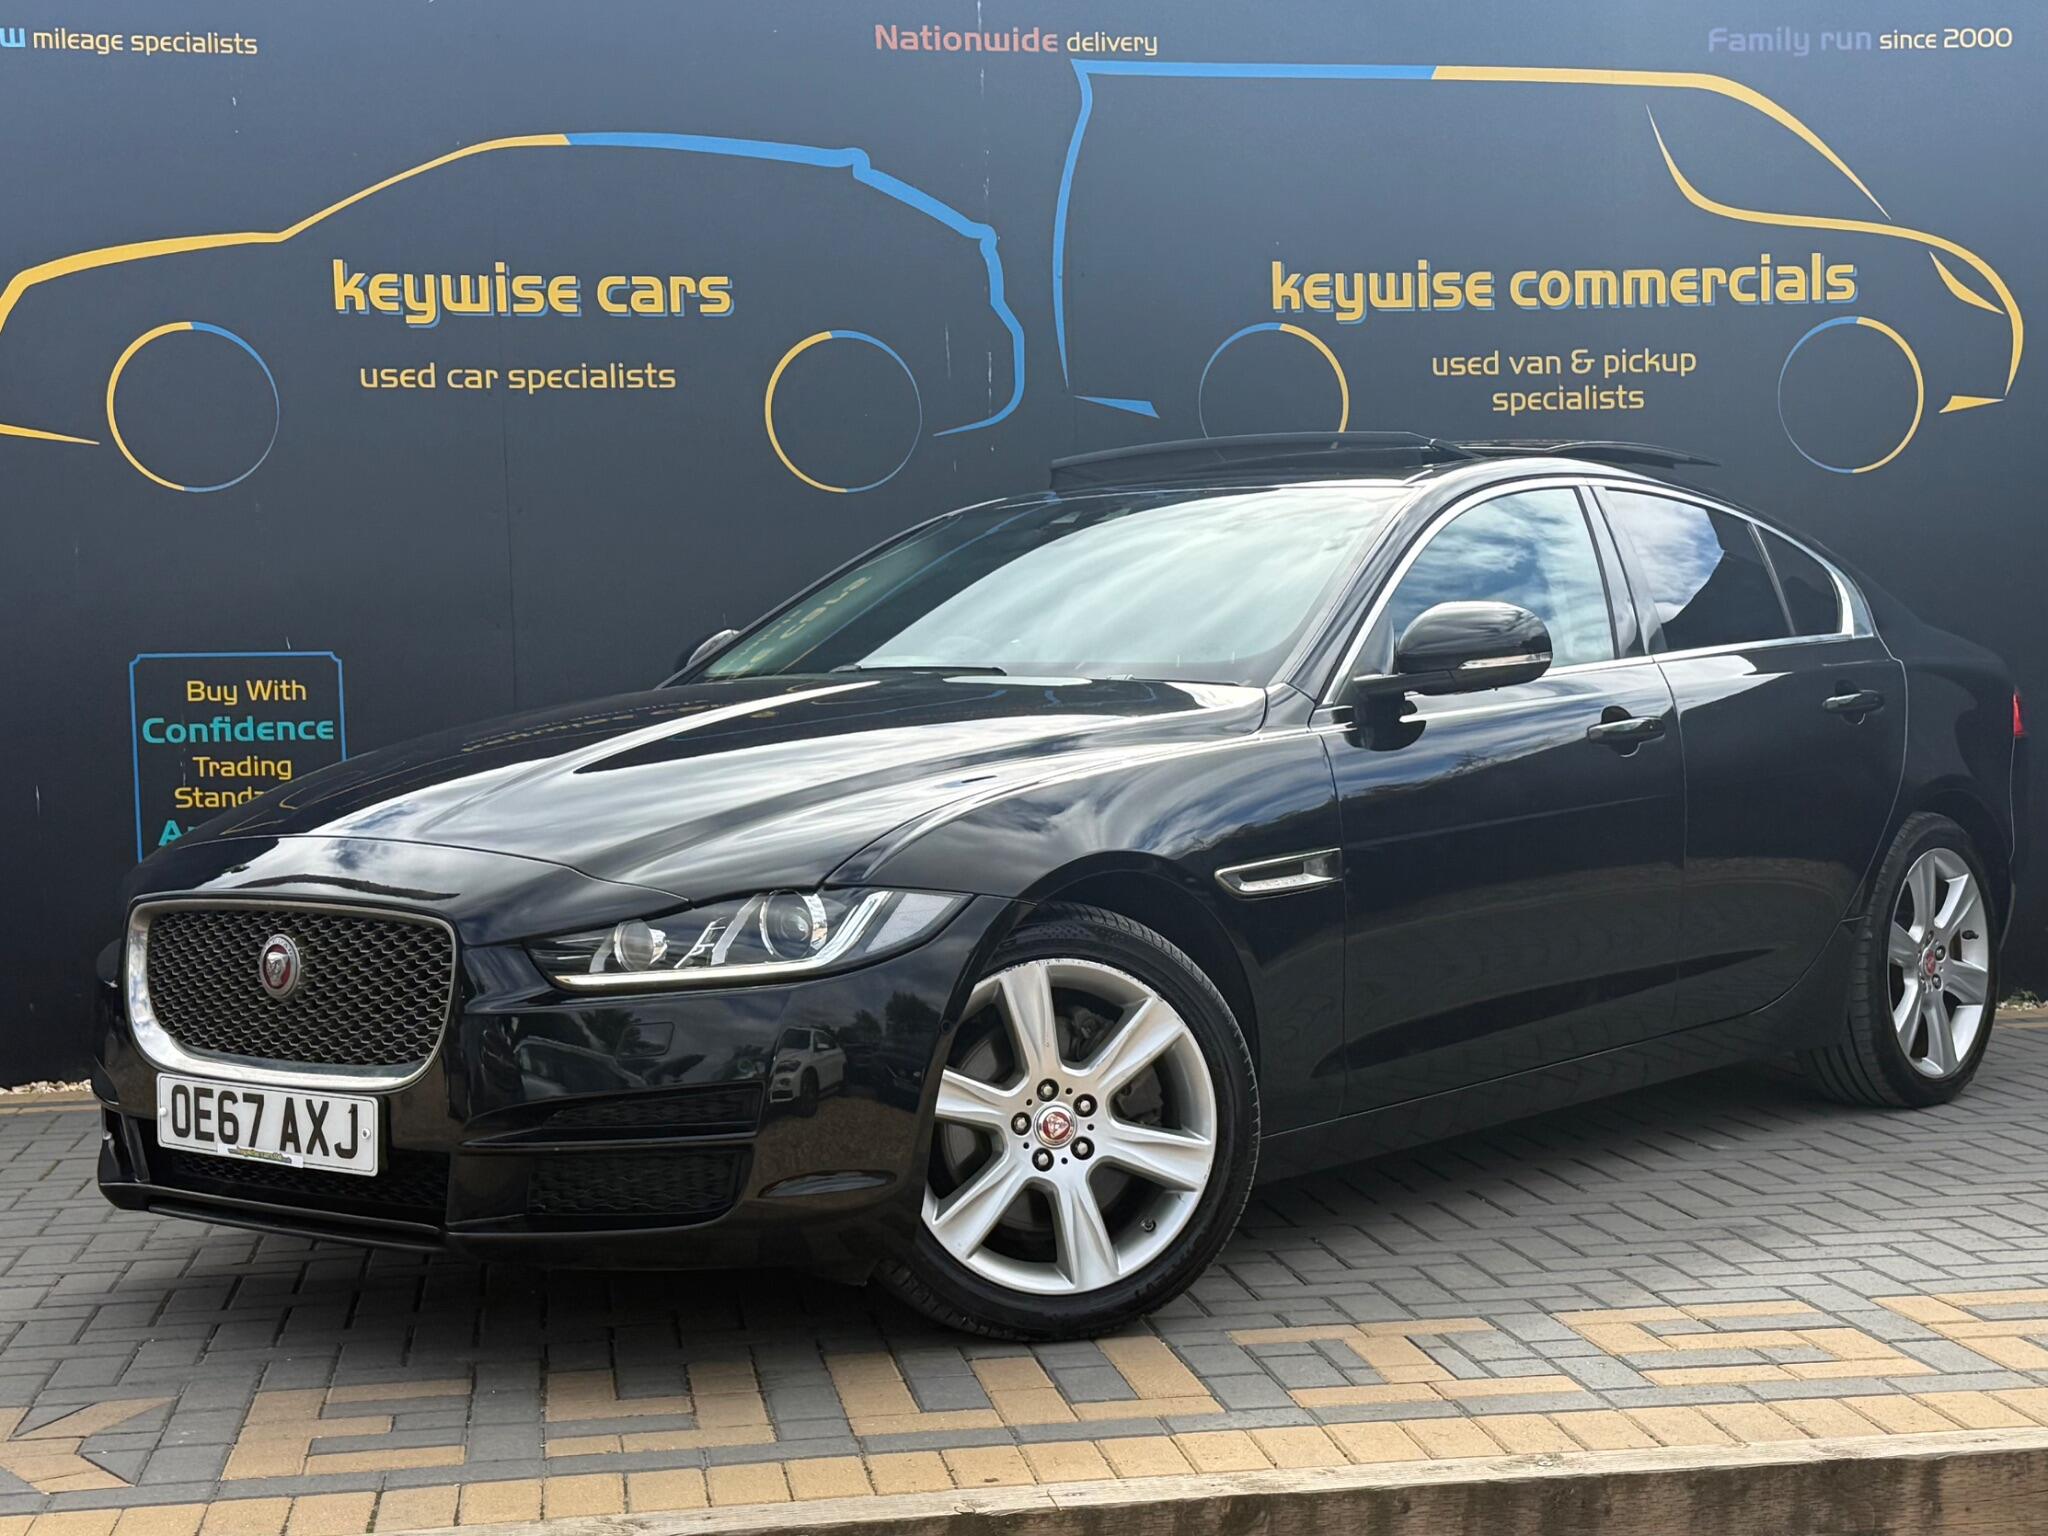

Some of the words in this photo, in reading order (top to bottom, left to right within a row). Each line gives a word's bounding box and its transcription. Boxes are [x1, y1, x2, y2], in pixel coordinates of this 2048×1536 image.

[33, 28, 123, 54] mileage
[131, 32, 258, 56] specialists
[874, 24, 1058, 52] Nationwide
[1066, 32, 1158, 56] delivery
[1708, 27, 1809, 56] Family
[1821, 31, 1872, 51] run
[1879, 30, 1937, 50] since
[1943, 27, 2013, 48] 2000
[332, 259, 581, 328] keywise
[597, 275, 735, 317] cars
[1272, 259, 1494, 325] keywise
[1509, 253, 1858, 310] commercials
[360, 362, 436, 389] used
[447, 368, 498, 389] car
[508, 362, 677, 395] specialists
[1432, 350, 1499, 377] used
[1509, 352, 1561, 376] van
[1570, 349, 1594, 374] &
[1604, 349, 1697, 379] pickup
[1492, 384, 1645, 416] specialists
[186, 680, 238, 706] Buy
[246, 680, 307, 701] With
[142, 716, 334, 744] Confidence
[192, 756, 292, 780] Trading
[174, 786, 265, 808] Stand
[171, 1084, 265, 1148] OE67
[279, 1097, 359, 1160] AXJ
